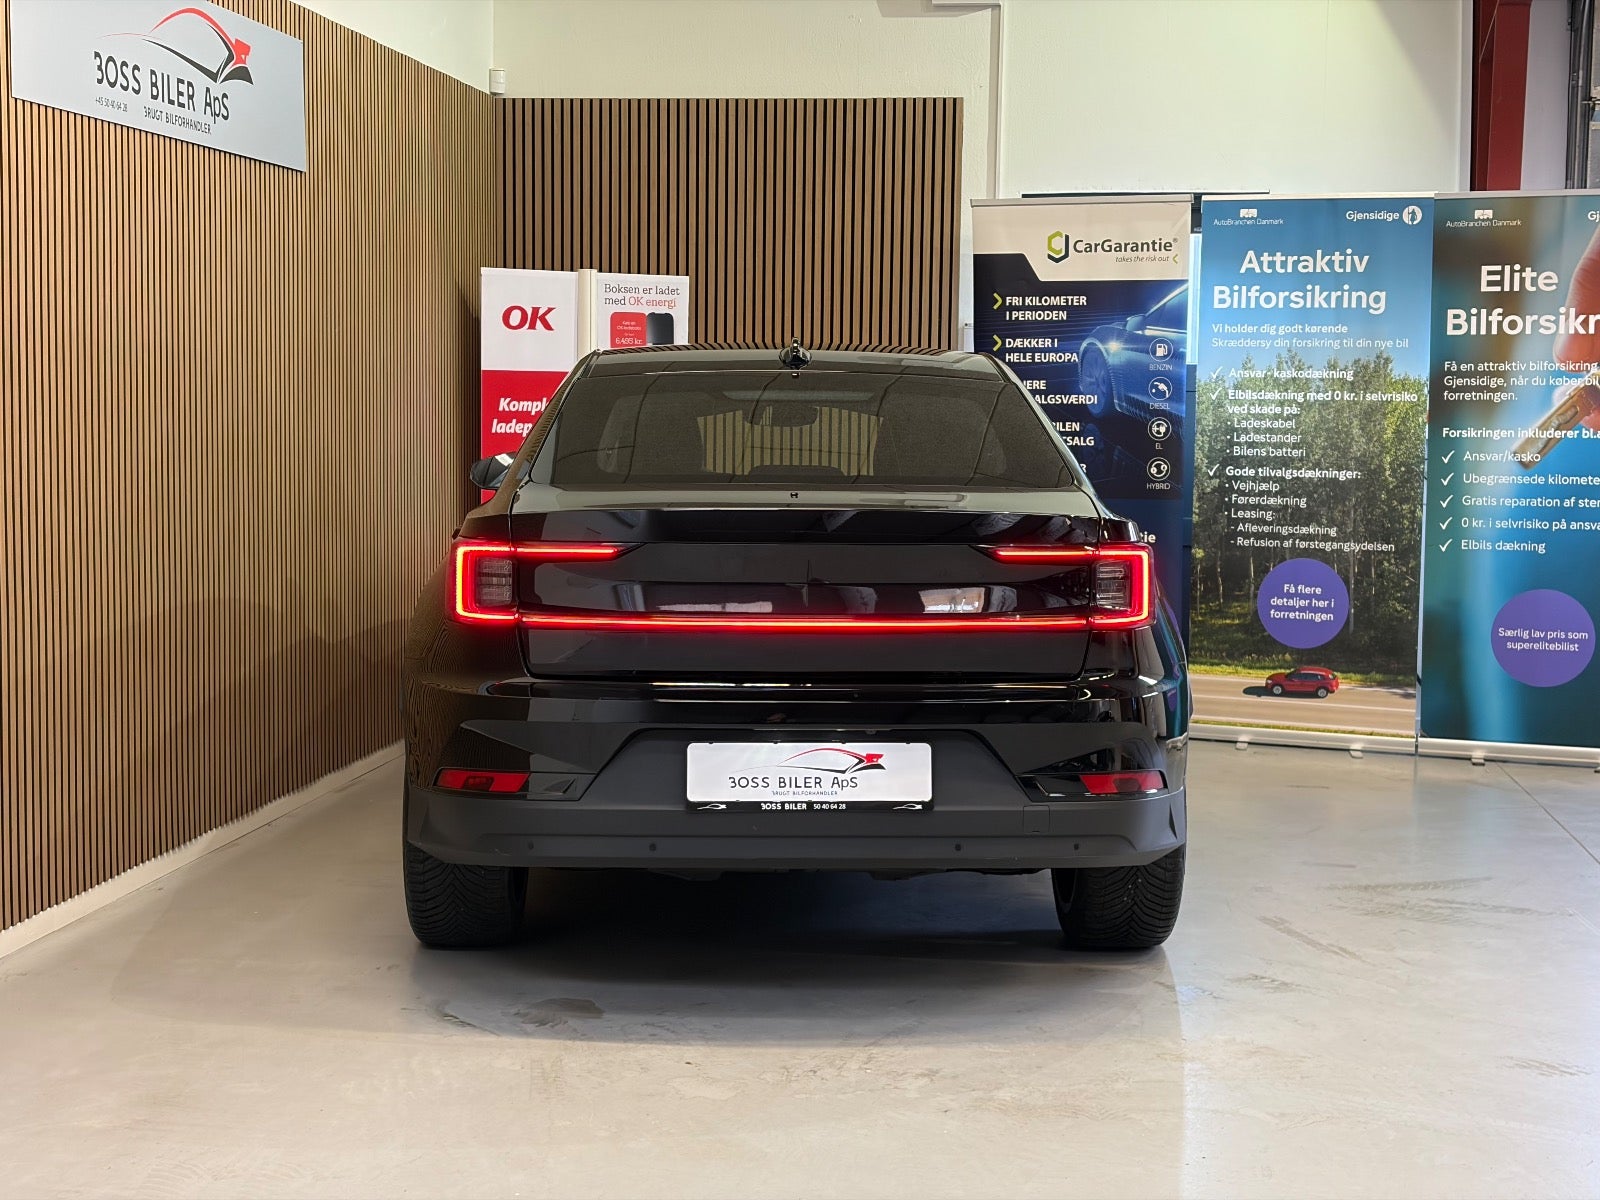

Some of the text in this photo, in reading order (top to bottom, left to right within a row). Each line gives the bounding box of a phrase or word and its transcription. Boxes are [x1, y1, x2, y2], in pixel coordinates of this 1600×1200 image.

[150, 69, 196, 112] BILER
[204, 86, 230, 124] ApS
[1213, 218, 1256, 226] AutoBranchen
[1346, 210, 1400, 222] Gjensidige
[1446, 219, 1522, 228] AutoBranchen Danmark
[1115, 255, 1132, 263] takes
[1133, 255, 1144, 263] the
[1145, 255, 1157, 263] risk
[1239, 248, 1370, 274] Attraktiv
[1480, 263, 1559, 292] Elite
[604, 283, 681, 296] Boksen er ladet
[604, 296, 677, 310] med OK energi
[1005, 296, 1087, 306] FRI KILOMETER
[1212, 284, 1386, 315] Bilforsikring
[502, 305, 557, 332] OK
[1005, 311, 1067, 321] I PERIODEN
[1212, 323, 1348, 335] Vi holder dig godt kørende
[1005, 338, 1052, 348] DÆKKER
[1211, 337, 1409, 350] Skræddersy din forsikring til din nye bil
[1005, 352, 1078, 362] HELE EUROPA
[1444, 360, 1598, 373] Få en attraktiv bilforsikring
[1273, 368, 1354, 380] kaskodækning
[1444, 375, 1599, 388] Gjensidige, når du køber bil
[1228, 390, 1304, 402] Elbilsdækning
[1306, 391, 1331, 401] med
[1333, 391, 1341, 401] 0
[1343, 391, 1358, 401] kr.
[1365, 391, 1418, 402] selvrisiko
[1443, 390, 1518, 403] forretningen.
[498, 397, 548, 415] Kompl
[1149, 402, 1171, 410] DIESEL
[1249, 404, 1282, 415] skade
[1283, 404, 1301, 416] på:
[1233, 418, 1296, 429] Ladeskabel
[1233, 432, 1302, 443] Ladestander
[1442, 427, 1515, 440] Forsikringen
[1517, 427, 1580, 439] inkluderer
[1155, 442, 1163, 450] EL
[1233, 446, 1306, 457] Bilens batteri
[1463, 450, 1541, 462] Ansvar/kasko
[1225, 466, 1362, 480] Gode tilvalgsdækninger:
[1462, 473, 1545, 486] Ubegrænsede
[1231, 480, 1280, 492] Vejhjælp
[1231, 495, 1307, 508] Førerdækning
[1462, 495, 1497, 506] Gratis
[1499, 496, 1561, 509] reparation
[1563, 496, 1576, 507] af
[1231, 508, 1276, 521] Leasing:
[1237, 523, 1337, 537] Afleveringsdækning
[1461, 517, 1469, 528] 0
[1472, 517, 1486, 528] kr.
[1495, 518, 1549, 529] selvrisiko
[1552, 518, 1567, 532] på
[1236, 537, 1395, 552] Refusion af førstegangsydelsen
[1461, 539, 1546, 554] Elbils dækning
[1283, 583, 1322, 595] Få flere
[1270, 596, 1309, 610] detaljer
[1312, 597, 1329, 608] her
[1270, 609, 1334, 623] forretningen
[1498, 627, 1589, 642] Særlig lav pris som
[1506, 640, 1580, 652] superelitebilist
[778, 776, 822, 788] BILER
[831, 776, 858, 791] ApS
[784, 802, 807, 810] BILER
